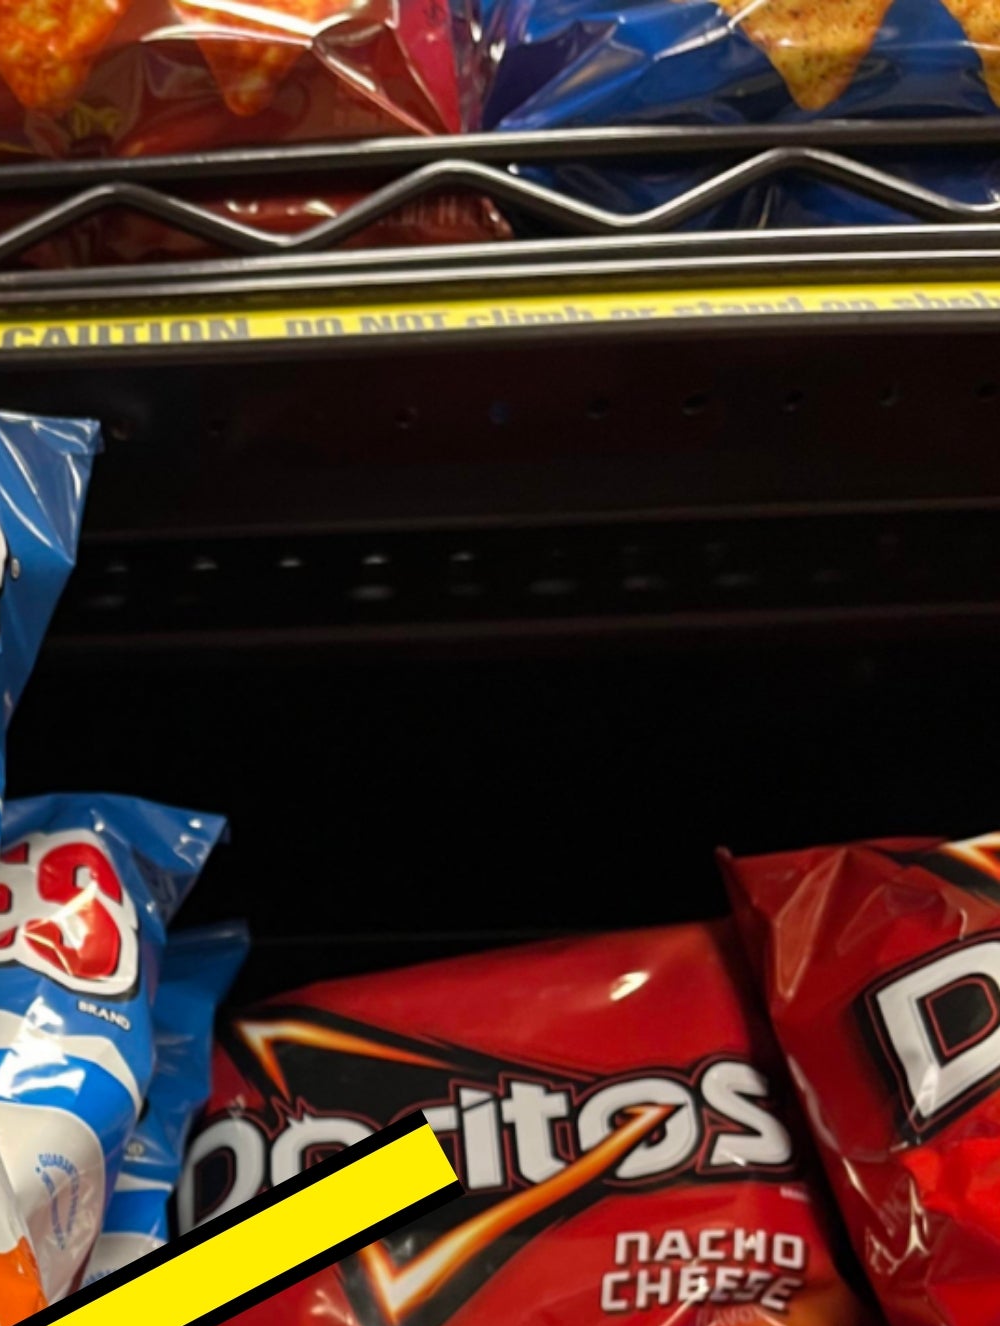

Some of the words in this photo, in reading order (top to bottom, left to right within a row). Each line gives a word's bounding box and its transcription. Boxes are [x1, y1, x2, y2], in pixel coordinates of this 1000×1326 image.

[2, 317, 250, 349] CAUTION
[77, 999, 131, 1032] BRAND
[615, 1227, 805, 1270] NACHO
[601, 1265, 804, 1312] CHEESE
